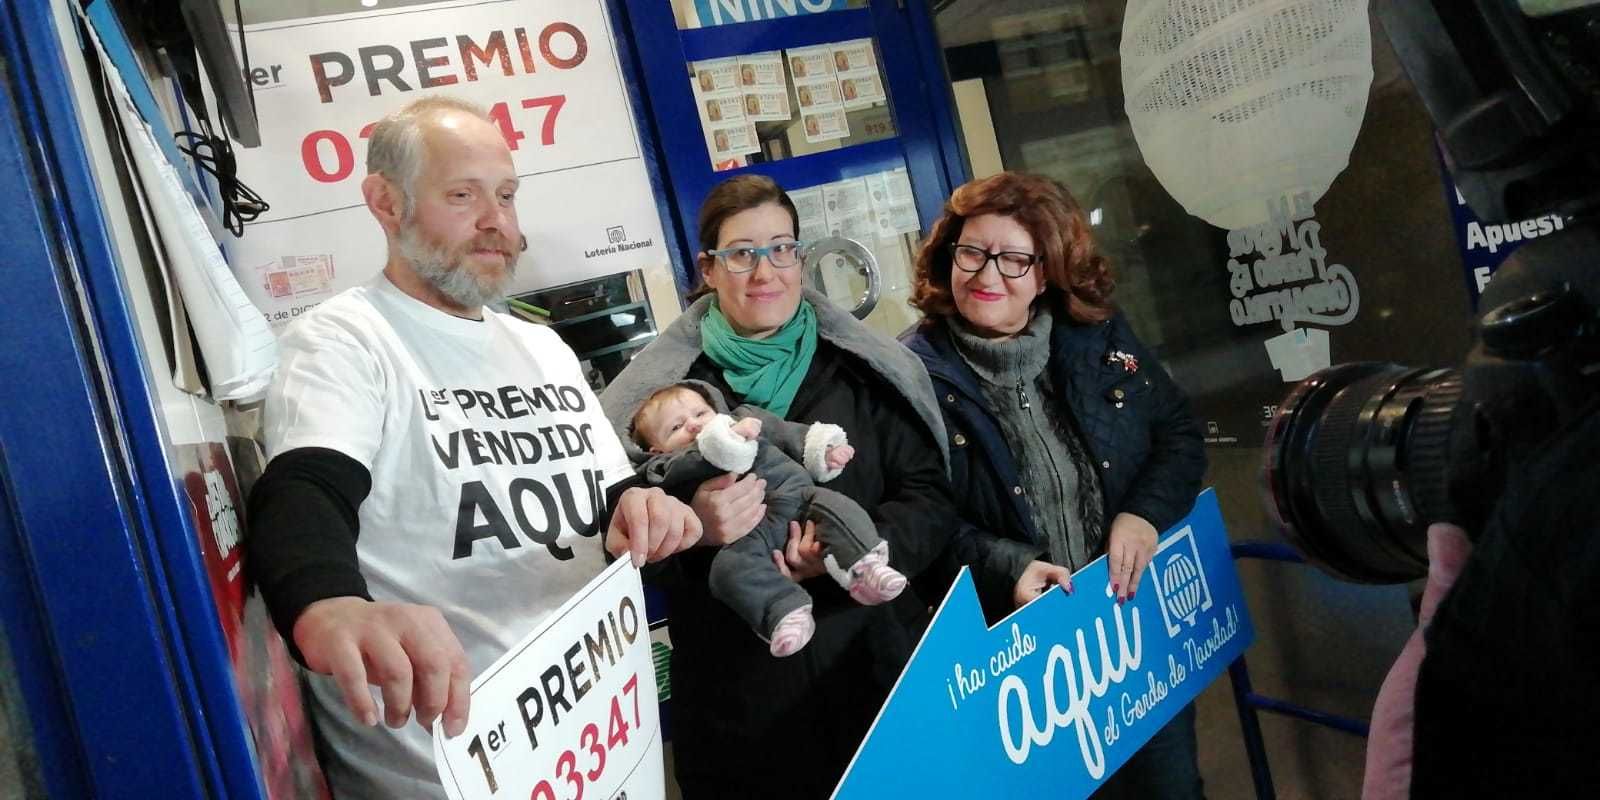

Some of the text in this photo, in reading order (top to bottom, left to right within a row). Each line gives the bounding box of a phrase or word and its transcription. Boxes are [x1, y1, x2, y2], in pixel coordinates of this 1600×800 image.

[249, 21, 589, 103] er PREMIO
[301, 94, 567, 184] 047
[618, 238, 653, 252] Nacional
[1466, 214, 1564, 253] Apuest
[452, 383, 586, 420] PREMIO
[467, 596, 639, 795] 1er PREMIO
[1104, 603, 1239, 746] el Gordo de Navidad!
